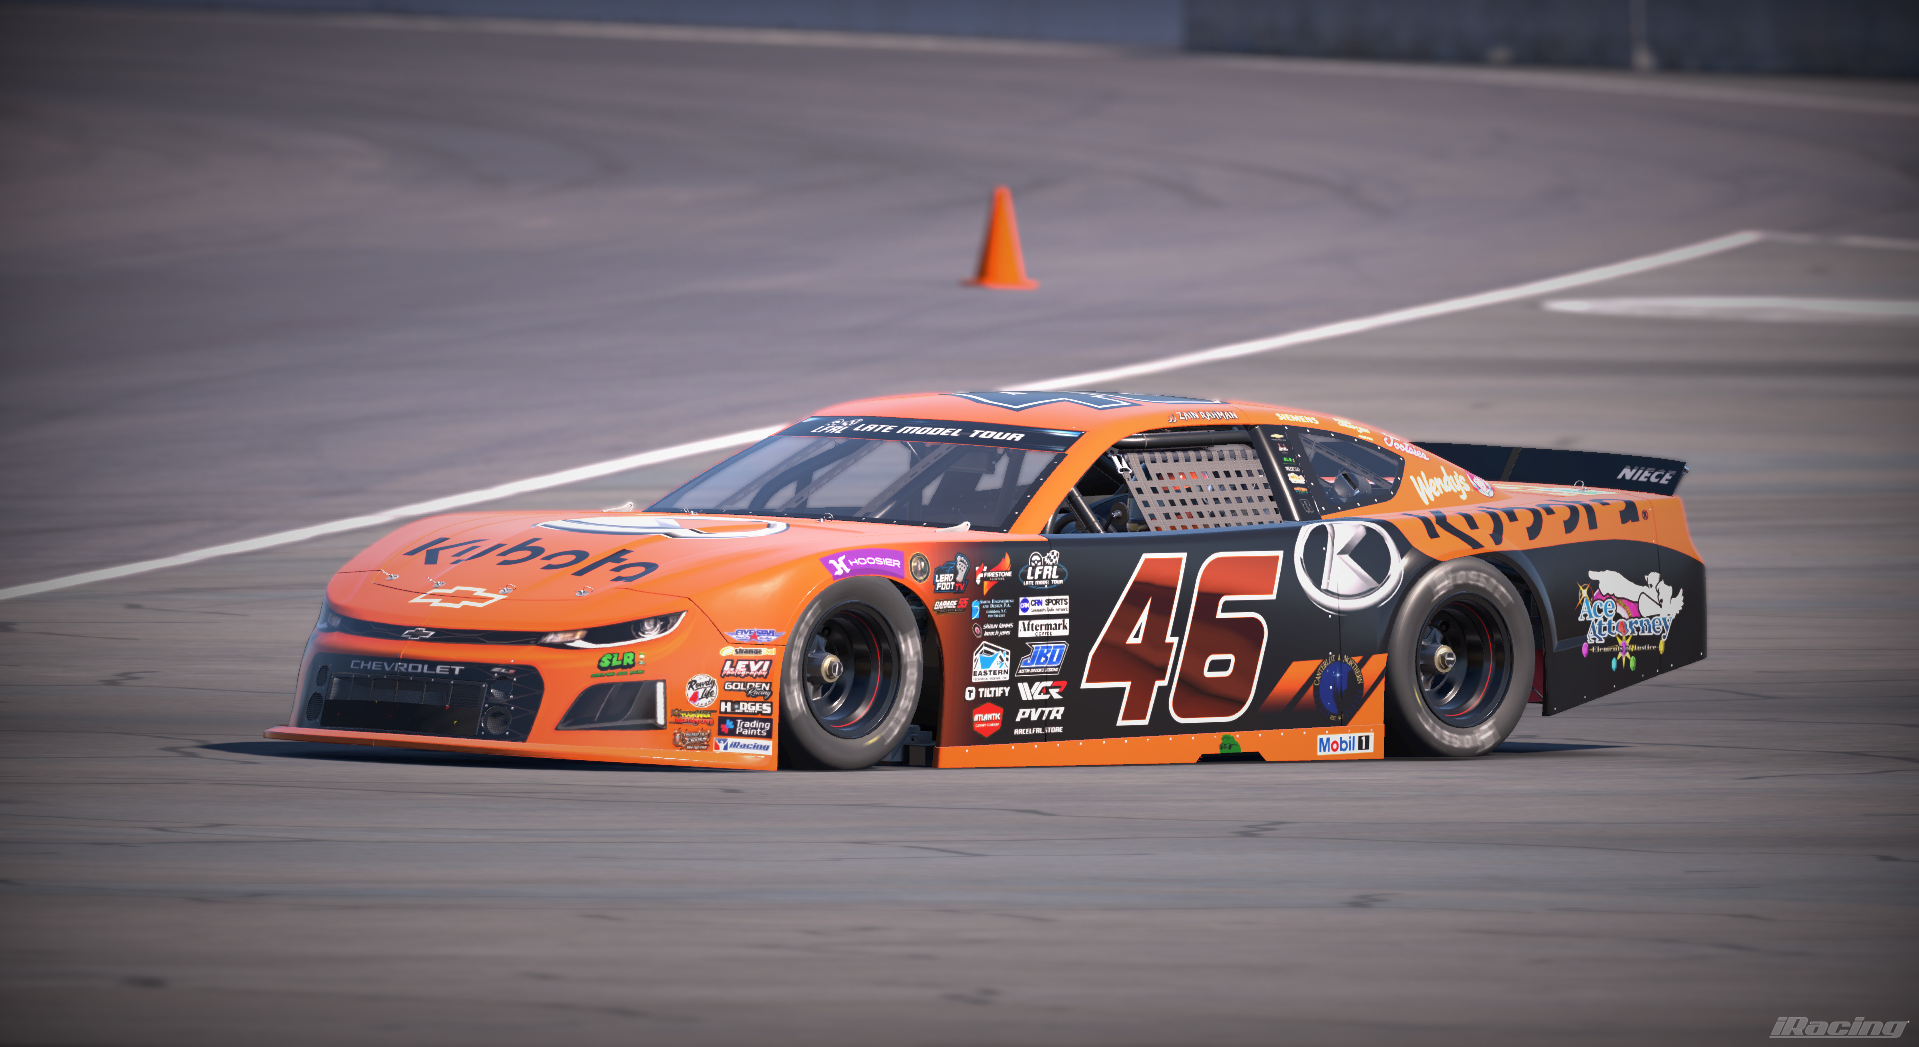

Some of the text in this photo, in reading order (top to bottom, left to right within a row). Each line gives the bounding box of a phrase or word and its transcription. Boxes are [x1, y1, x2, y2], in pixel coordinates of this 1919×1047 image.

[1175, 411, 1238, 421] ZAIN RAHMAN
[1275, 412, 1319, 424] SIEMENS
[853, 423, 897, 433] LATE
[896, 426, 962, 437] MODEL
[969, 429, 1025, 442] TOUR
[1616, 465, 1677, 485] NIECE
[1409, 465, 1471, 506] Wendy's
[402, 537, 660, 583] Kubota
[848, 556, 901, 569] HOOSIER
[936, 582, 966, 591] FOOT TV
[1045, 598, 1068, 606] SPORTS
[1578, 597, 1617, 621] Ace
[1019, 619, 1068, 632] Aftermark
[1587, 616, 1674, 644] Attorney
[1080, 550, 1284, 726] 46
[350, 659, 466, 676] CHEVROLET
[597, 651, 636, 671] SLR
[723, 660, 771, 671] LEVI
[973, 669, 1009, 677] EASTERN
[724, 681, 771, 691] GOLDEN
[978, 686, 1011, 698] TILTIFY
[973, 712, 1001, 722] ATLANTIC
[1015, 707, 1065, 722] PVTR
[736, 719, 771, 730] Trading
[735, 727, 767, 736] Paints
[728, 740, 771, 752] iRacing
[1318, 735, 1356, 753] Mobil
